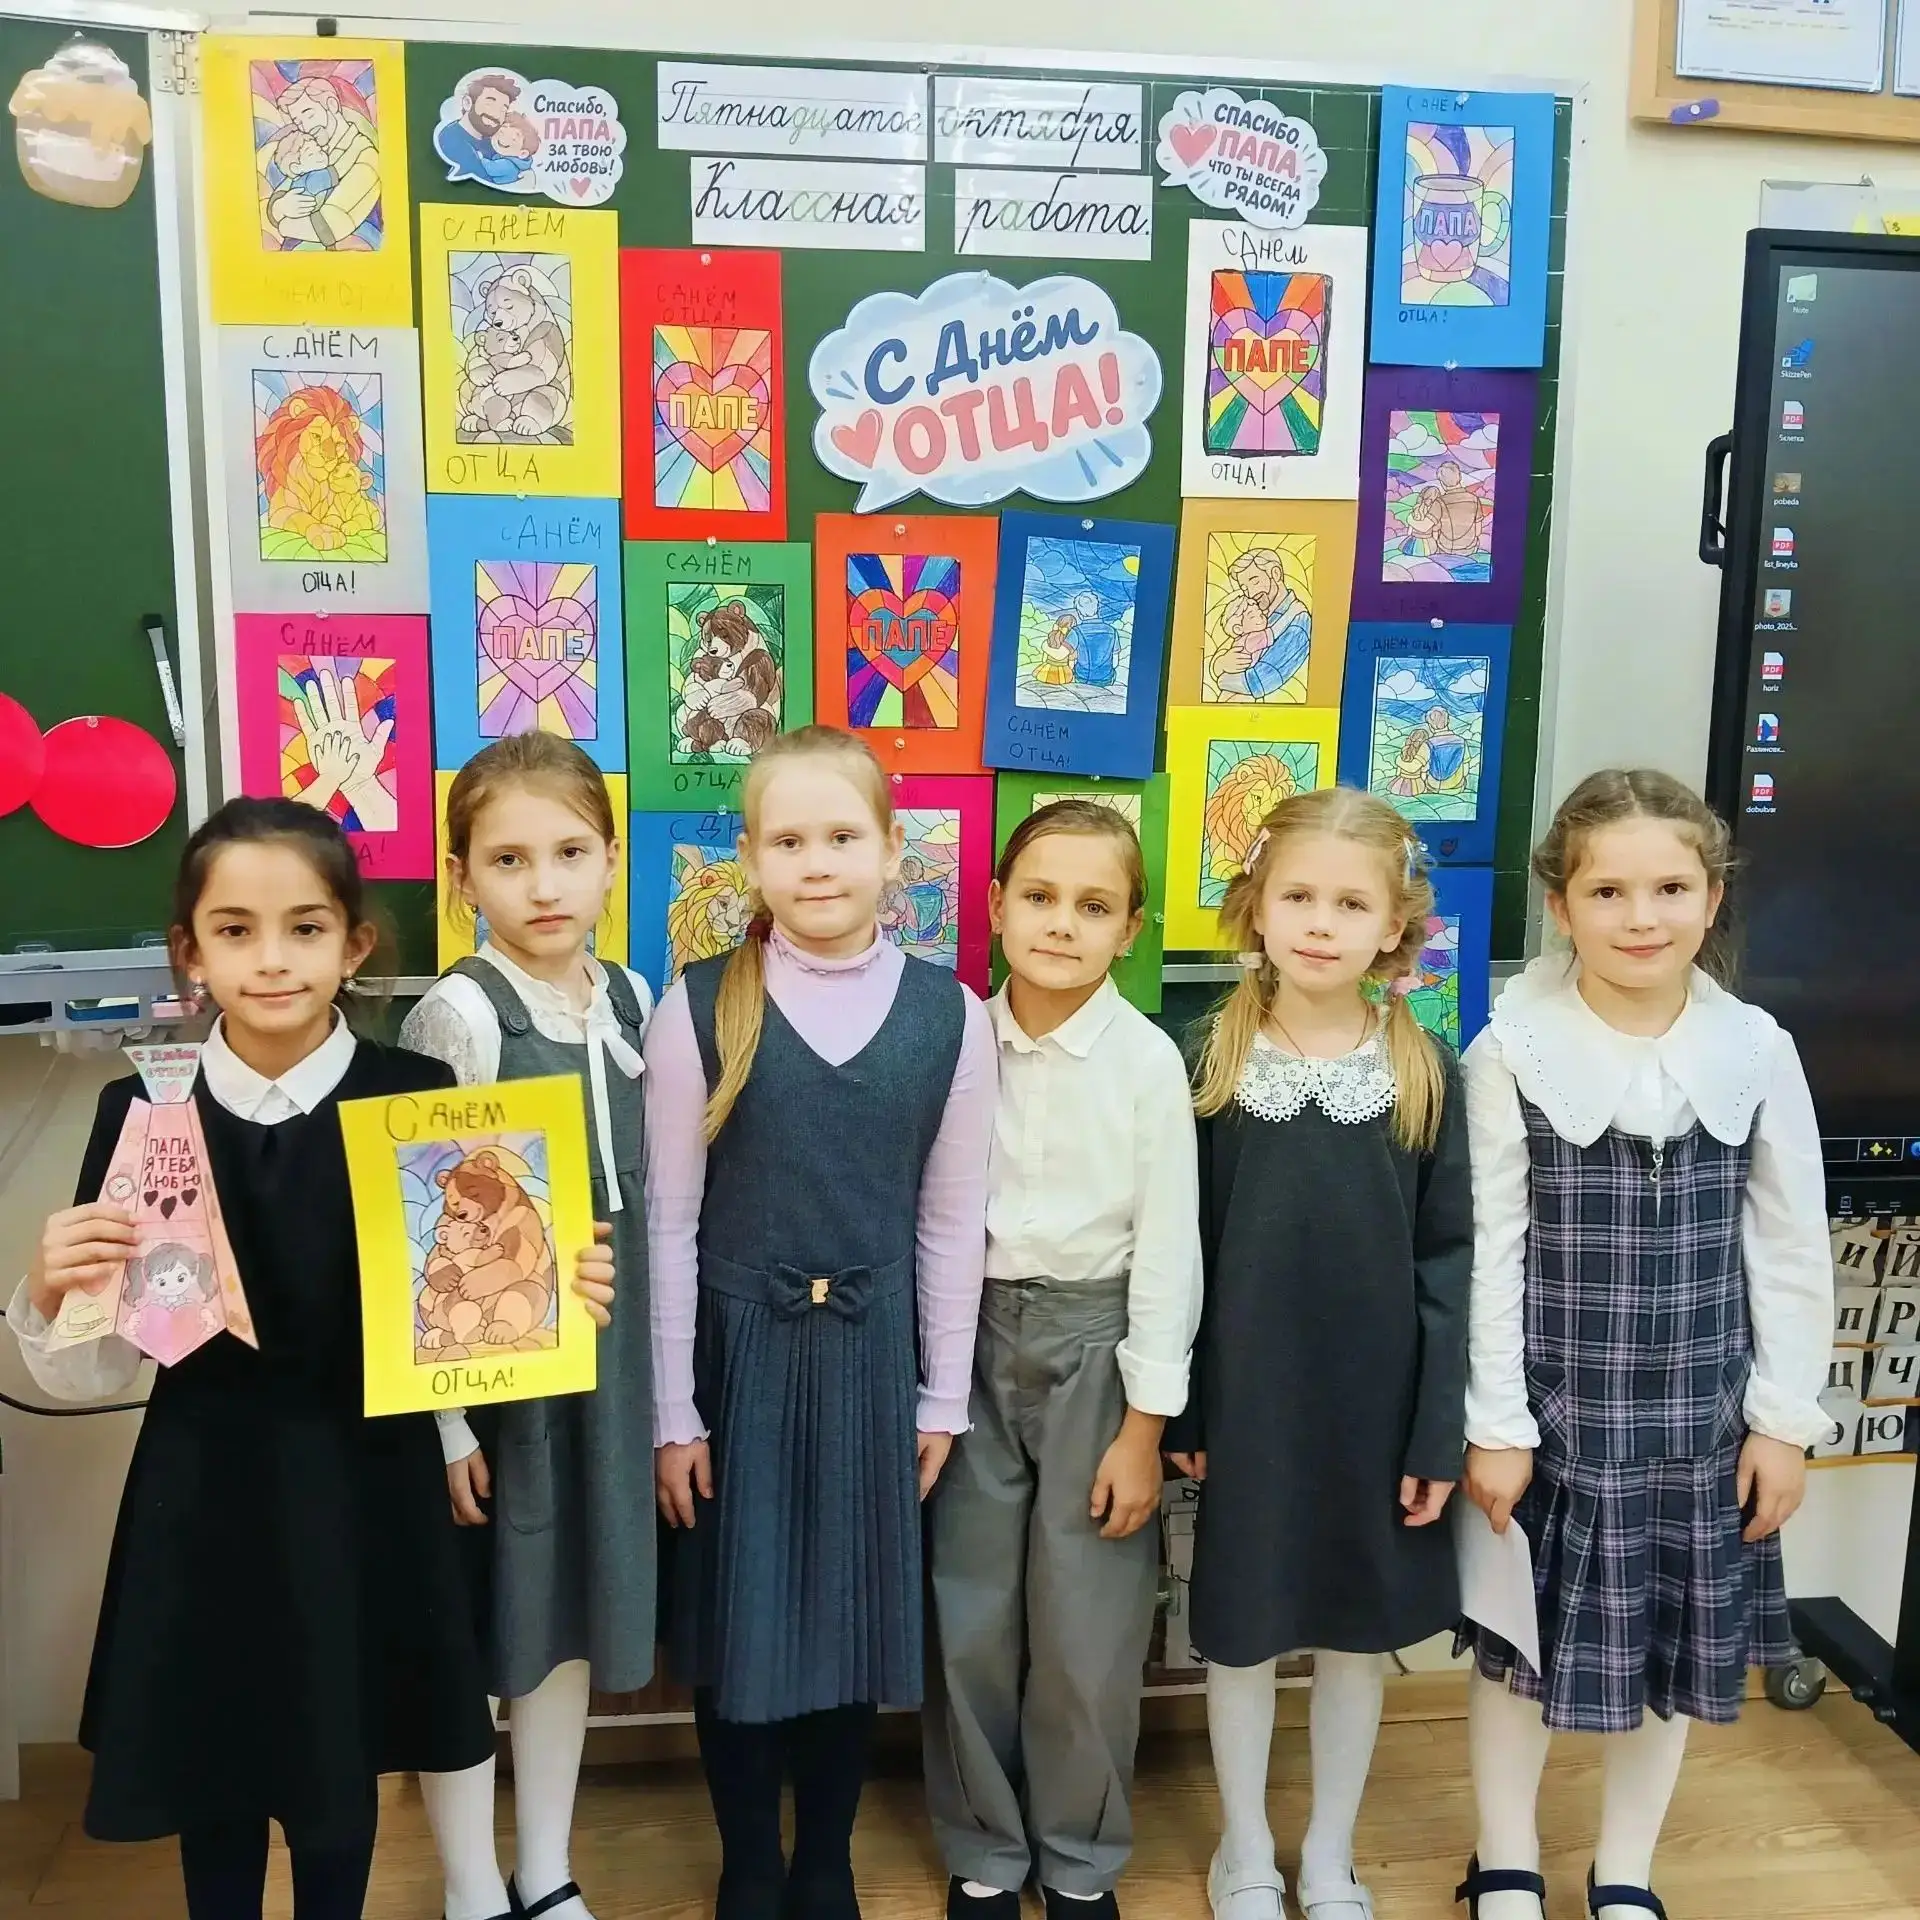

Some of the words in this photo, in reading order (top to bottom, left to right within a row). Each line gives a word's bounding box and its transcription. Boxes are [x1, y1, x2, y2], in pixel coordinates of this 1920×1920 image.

[534, 94, 607, 117] Спасибо,
[544, 117, 616, 145] ПАПА,
[662, 80, 922, 145] Пятнадцатое
[938, 86, 1139, 167] октября.
[1214, 103, 1300, 149] СПАСИБО,
[545, 158, 615, 176] любовь!
[548, 144, 567, 156] за
[572, 144, 612, 156] твою
[1217, 129, 1301, 183] ПАПА,
[1208, 159, 1232, 176] ЧТО
[1236, 166, 1253, 182] ТЫ
[1256, 173, 1301, 201] ВСЕГДА
[695, 161, 920, 224] Классная
[958, 175, 1149, 253] работа.
[1224, 181, 1295, 219] РЯДОМ!
[1420, 208, 1478, 236] ПАПА
[1398, 309, 1447, 323] ОТЦА!
[864, 338, 915, 405] С
[926, 305, 1100, 396] Днём
[1223, 338, 1310, 373] ПАПЕ
[669, 393, 759, 431] ПАПЕ
[893, 352, 1124, 475] ОТЦА!
[446, 447, 540, 484] ОТЦА
[1211, 462, 1266, 490] ОТЦА!
[302, 570, 356, 594] ОТЦА!
[492, 625, 585, 661] ПАПЕ
[861, 618, 948, 652] ПАПЕ
[1009, 743, 1071, 768] ОТЦА!
[149, 1137, 191, 1154] ПАПА
[144, 1156, 154, 1171] Я
[158, 1156, 196, 1173] ТЕБЯ
[432, 1366, 515, 1396] ОТЦА!
